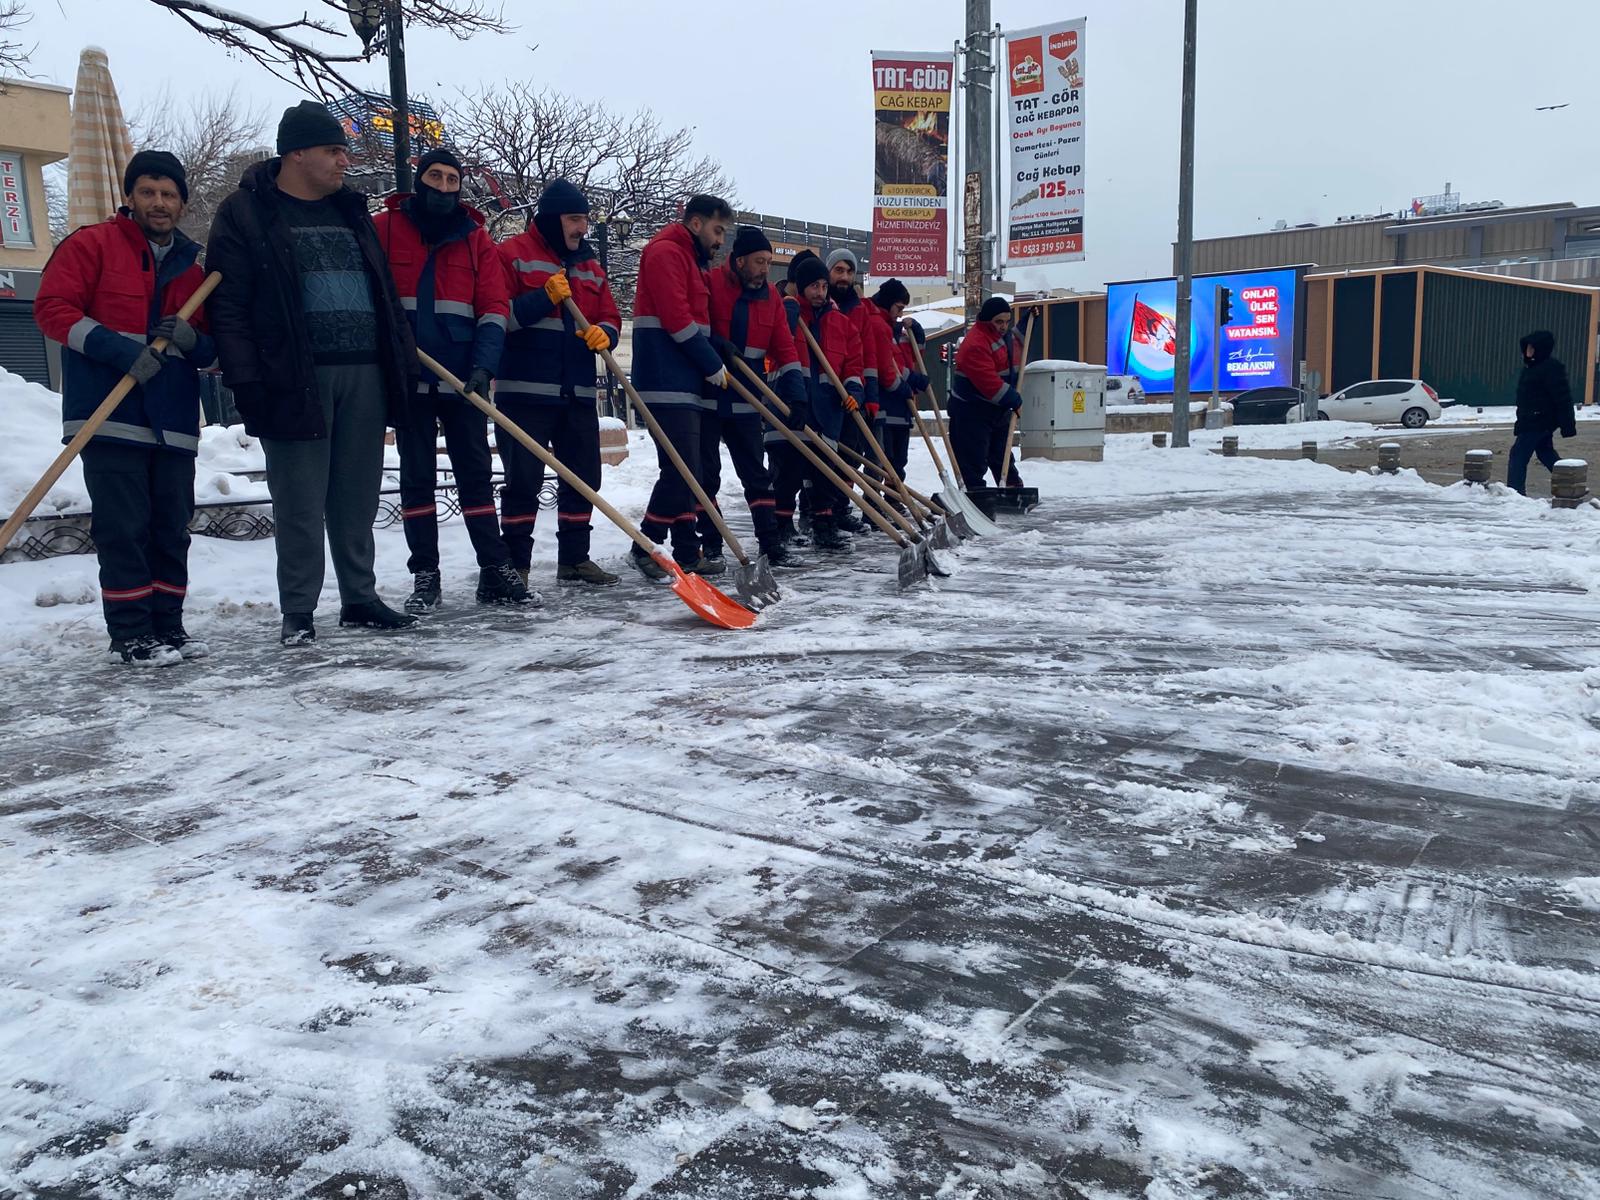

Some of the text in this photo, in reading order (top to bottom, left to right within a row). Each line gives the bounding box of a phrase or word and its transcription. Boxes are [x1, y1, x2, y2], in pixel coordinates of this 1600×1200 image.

[1049, 39, 1076, 50] İNDİRİM
[874, 65, 949, 89] TAT-GÖR
[880, 95, 943, 108] CAĞ KEBAP
[1015, 97, 1040, 111] TAT
[1051, 88, 1079, 104] GÖR
[1015, 105, 1079, 124] CAĞ KEBAPDA
[1013, 121, 1081, 139] Ocak Ayı Boyunca
[1015, 140, 1052, 153] Cumartesi
[1057, 136, 1080, 145] Pazar
[1034, 148, 1060, 160] Günleri
[1017, 164, 1081, 182] Cağ Kebap
[1, 161, 20, 232] TERZİ
[876, 196, 942, 207] KUZU ETİNDEN
[876, 220, 941, 229] HİZMETİNİZDEYİZ
[1022, 240, 1076, 254] 0533 319 50 24
[876, 262, 939, 272] 0533 319 50 24
[1242, 288, 1276, 299] ONLAR
[1250, 300, 1278, 311] ÜLKE,
[1255, 314, 1275, 324] SEN
[1228, 327, 1277, 337] VATANSIN.
[1249, 361, 1275, 370] AKSUN
